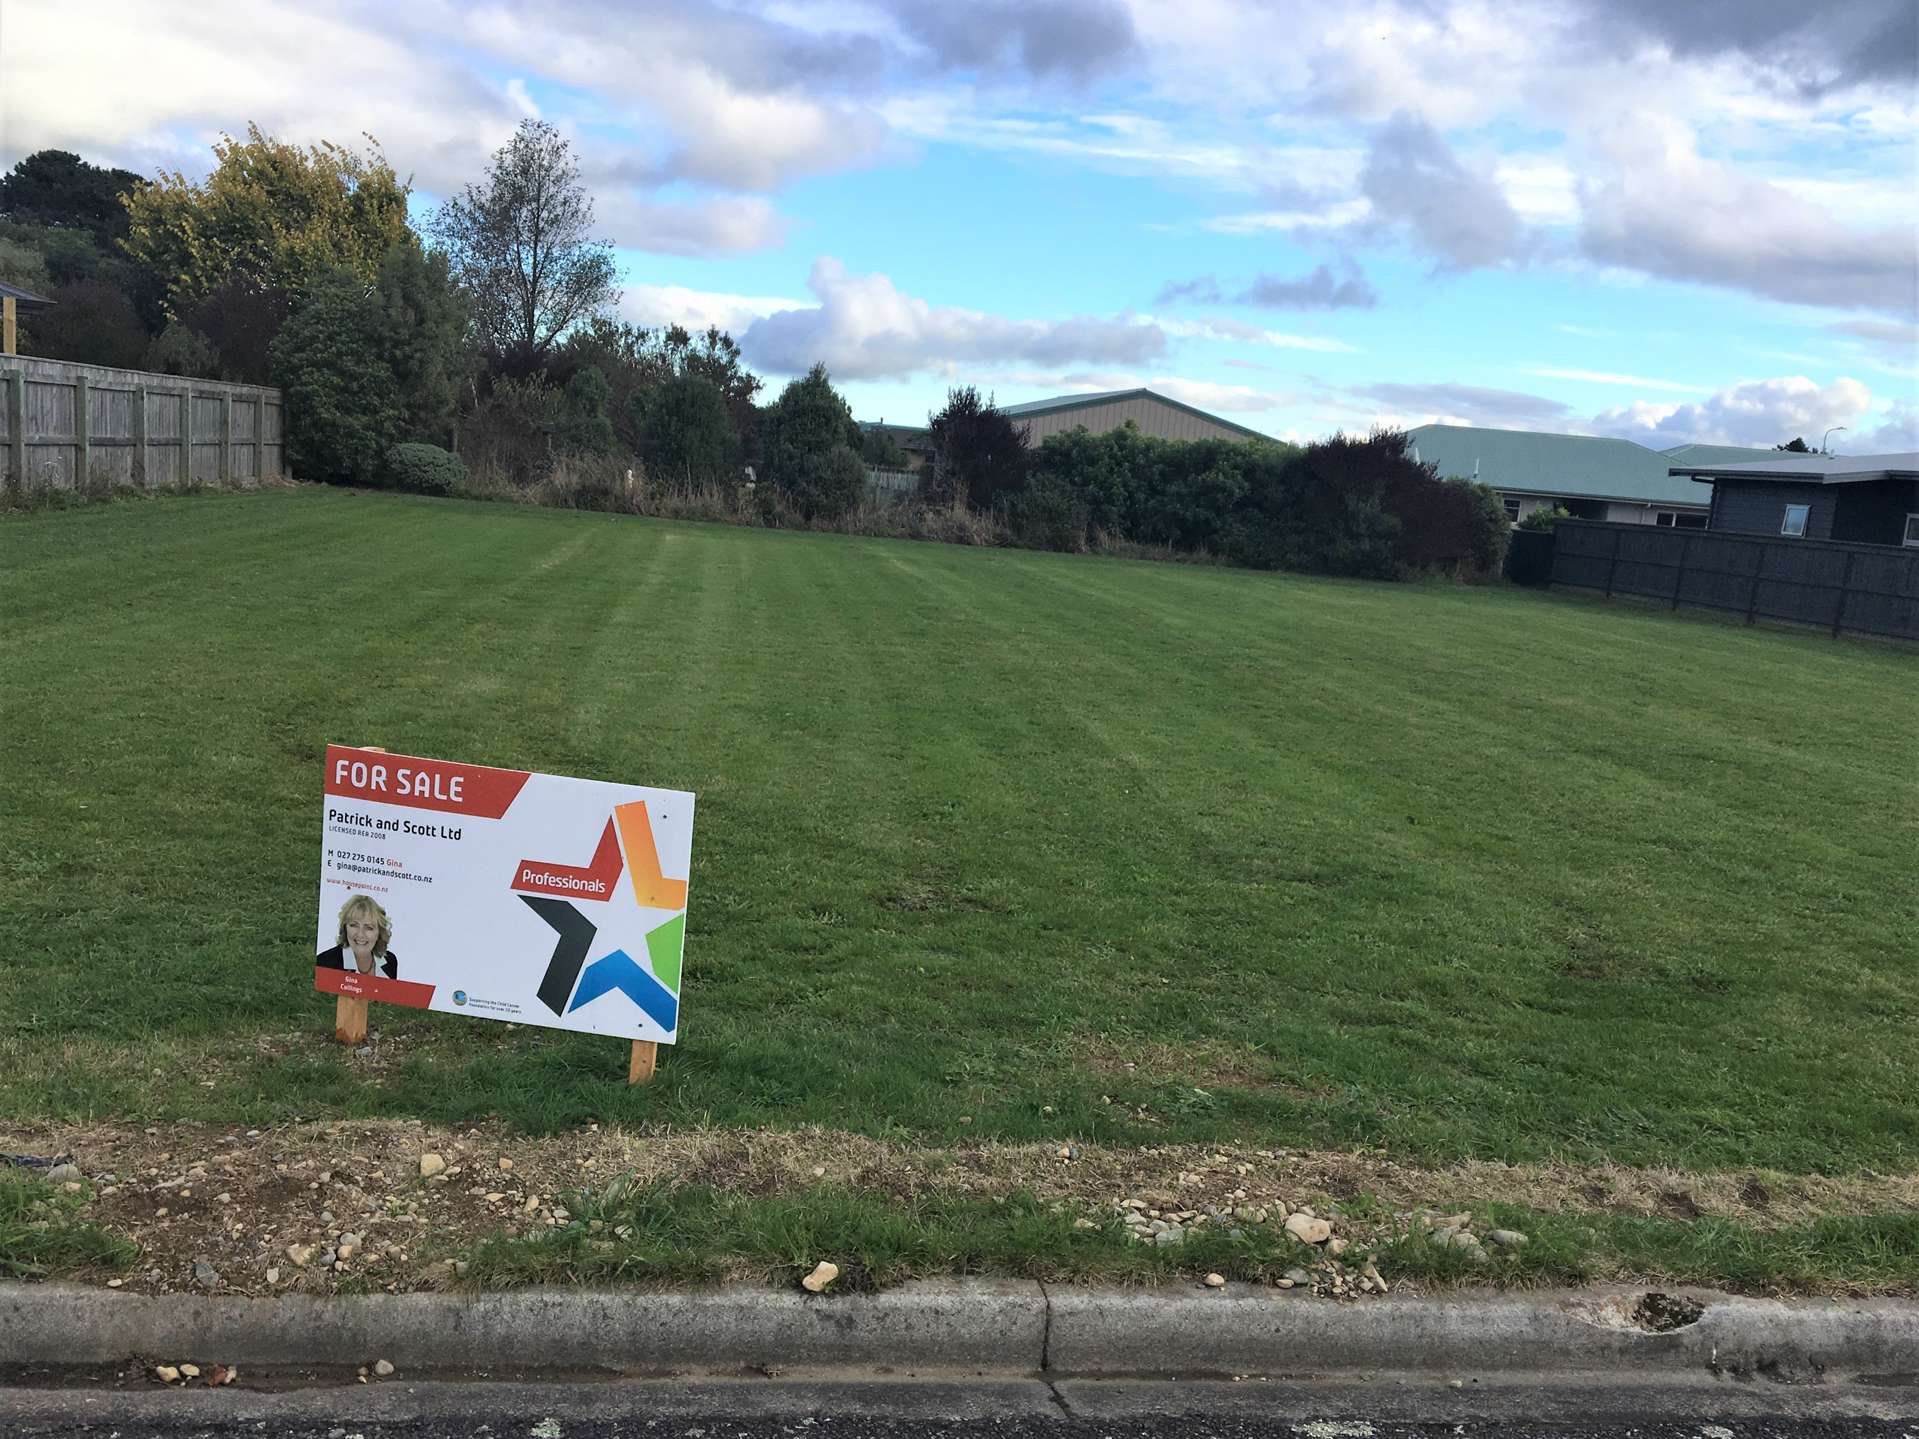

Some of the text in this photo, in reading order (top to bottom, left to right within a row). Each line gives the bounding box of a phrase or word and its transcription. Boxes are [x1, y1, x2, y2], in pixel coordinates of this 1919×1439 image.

[335, 759, 465, 802] FOR SALE
[328, 809, 462, 841] Patrick and Scott Ltd
[328, 825, 357, 837] LICENSED
[370, 831, 386, 840] 2008
[327, 849, 403, 868] M 027 275 0145 Gina
[327, 859, 433, 883] E gina@patrickandscott.co.nz
[522, 869, 606, 893] Professionals
